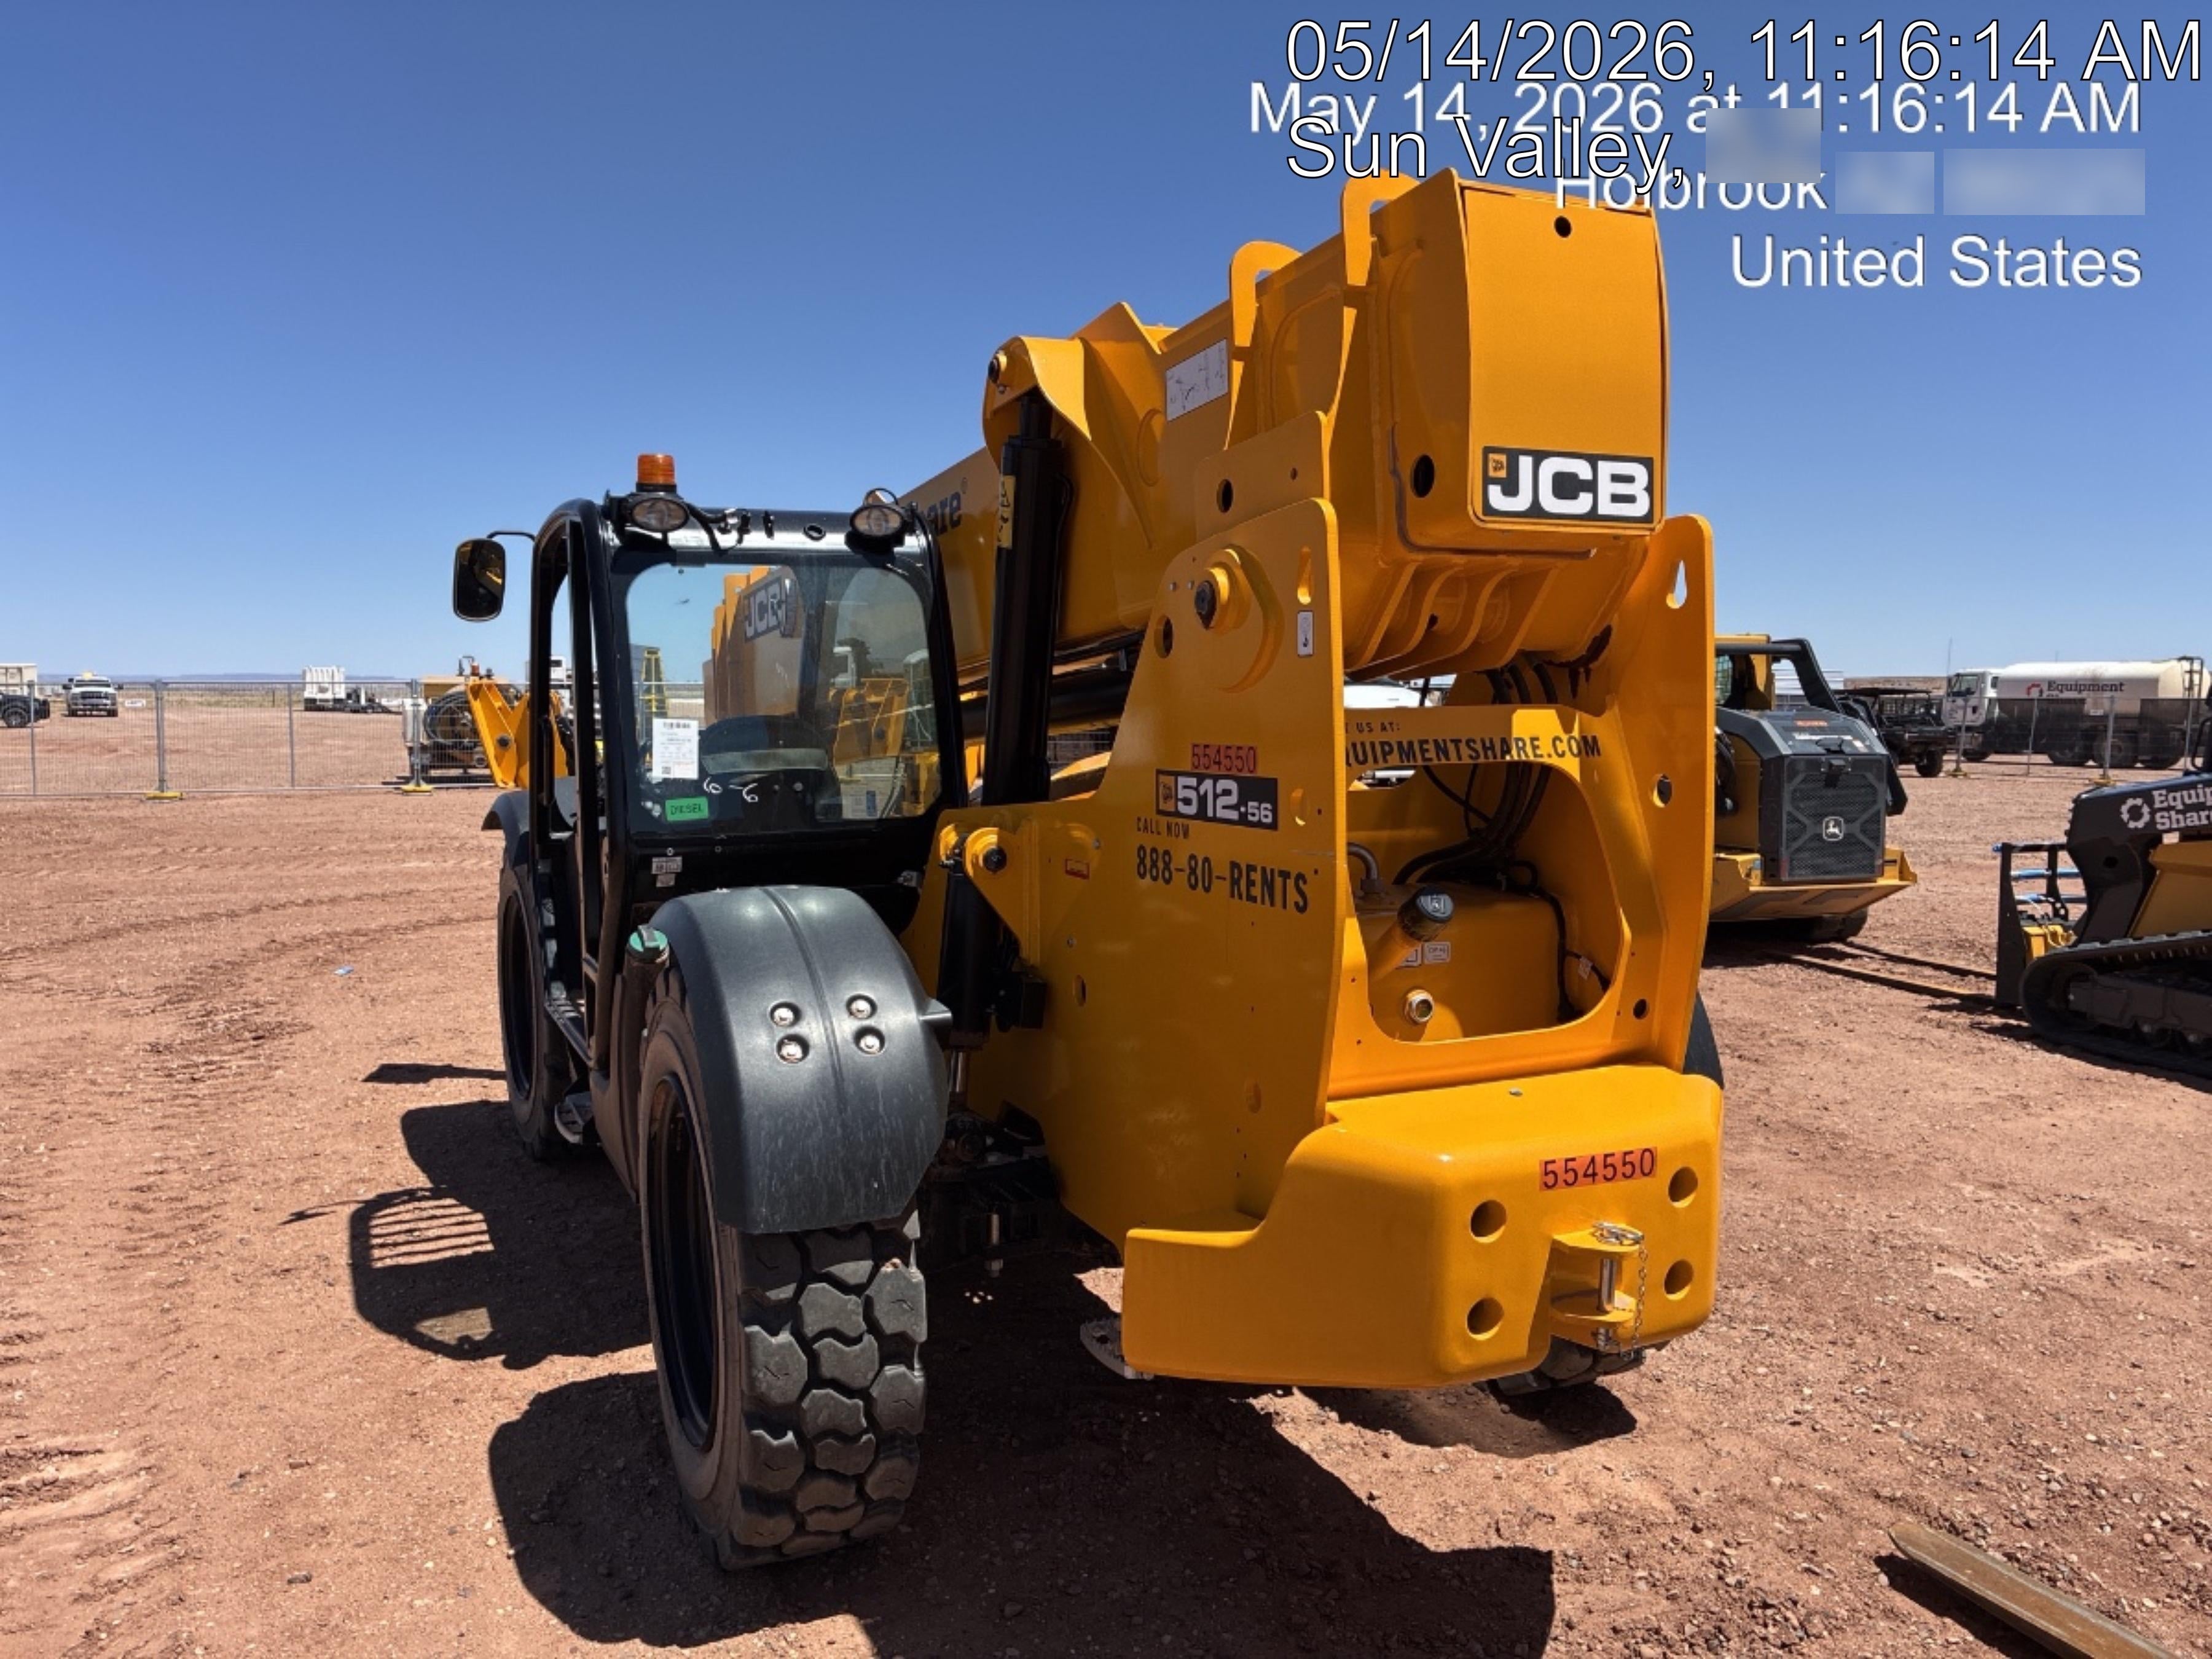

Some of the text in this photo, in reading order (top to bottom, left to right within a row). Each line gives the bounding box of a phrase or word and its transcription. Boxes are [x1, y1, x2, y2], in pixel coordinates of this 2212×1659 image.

[1487, 455, 1650, 517] JCB
[2047, 680, 2125, 694] Equipment
[1356, 722, 1374, 734] US
[1191, 744, 1257, 773] 554550
[670, 803, 703, 815] DIESEL
[2155, 810, 2212, 830] Shar
[1137, 817, 1190, 839] CALL NOW
[1137, 844, 1308, 914] 888-80-RENTS
[1543, 1148, 1655, 1189] 554550
